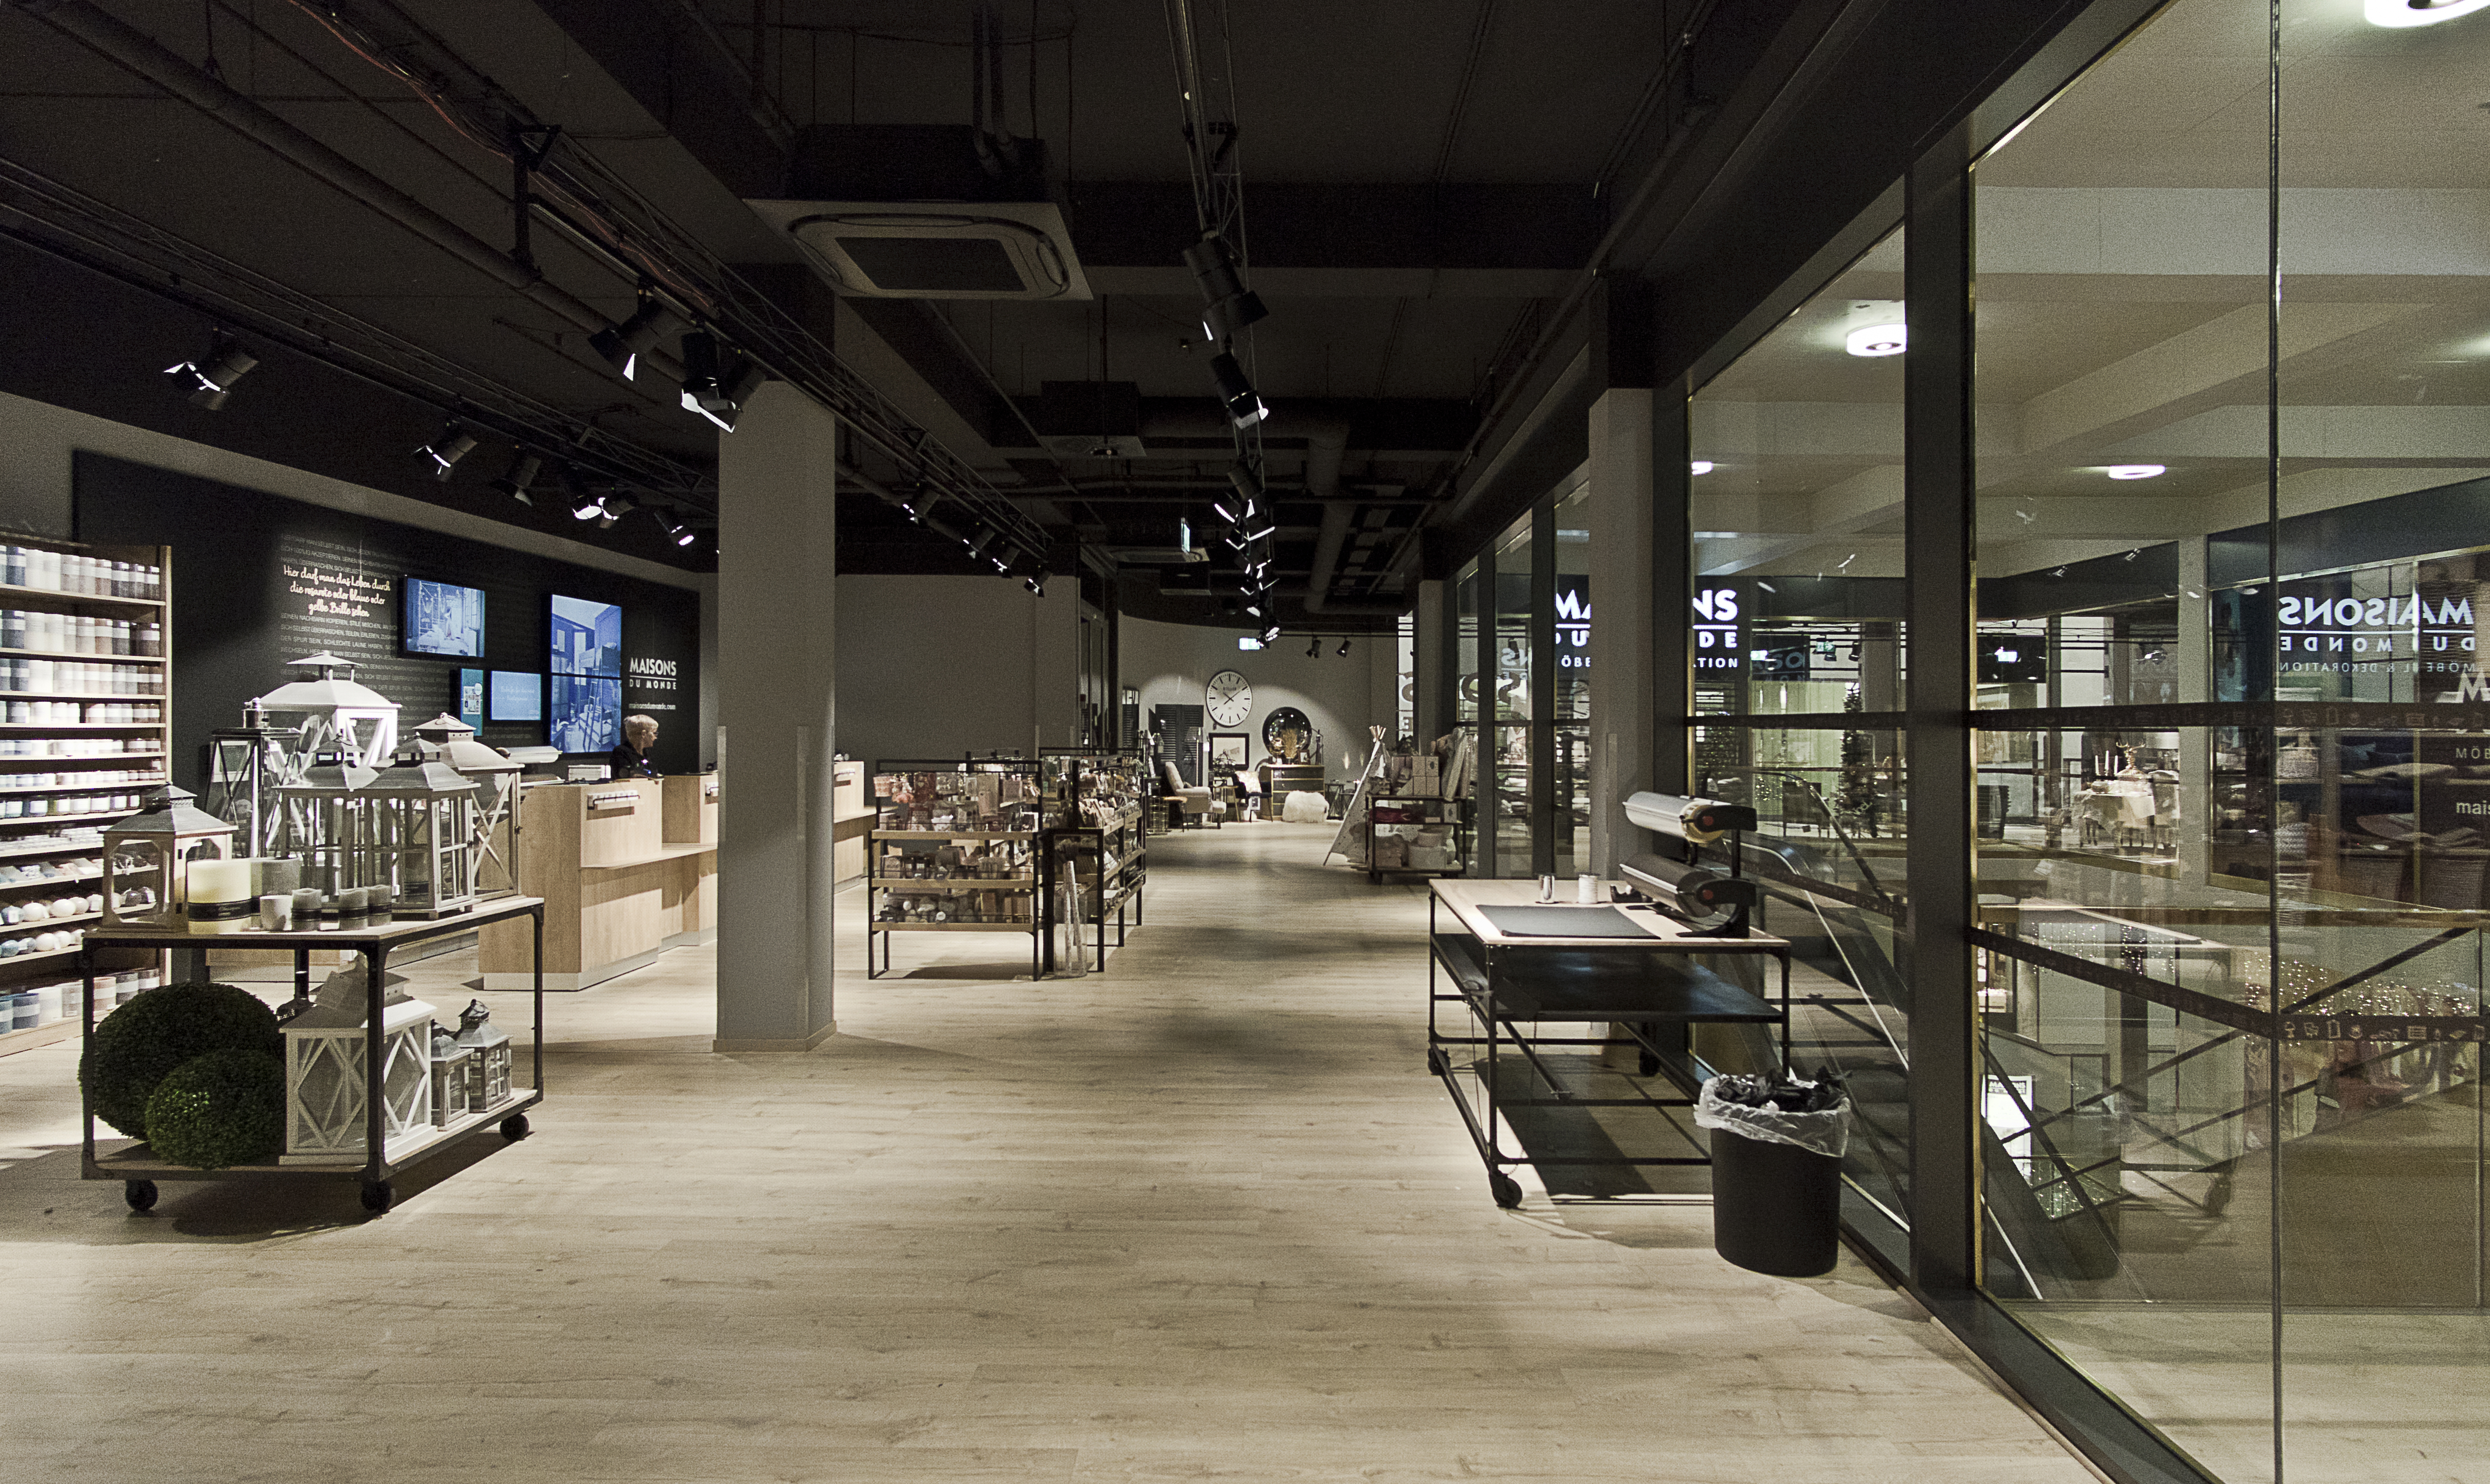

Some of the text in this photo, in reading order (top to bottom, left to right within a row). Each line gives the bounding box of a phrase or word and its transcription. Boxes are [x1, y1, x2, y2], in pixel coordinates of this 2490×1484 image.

[284, 565, 390, 591] Hier darf man das Leben durch
[290, 581, 303, 593] die
[333, 587, 349, 599] oder
[349, 588, 370, 602] blaue
[370, 593, 385, 604] oder
[308, 599, 328, 615] gelbe
[330, 601, 351, 615] Brille
[629, 657, 677, 676] MAISONS
[1693, 657, 1738, 668] TION
[629, 679, 677, 690] DU MONDE
